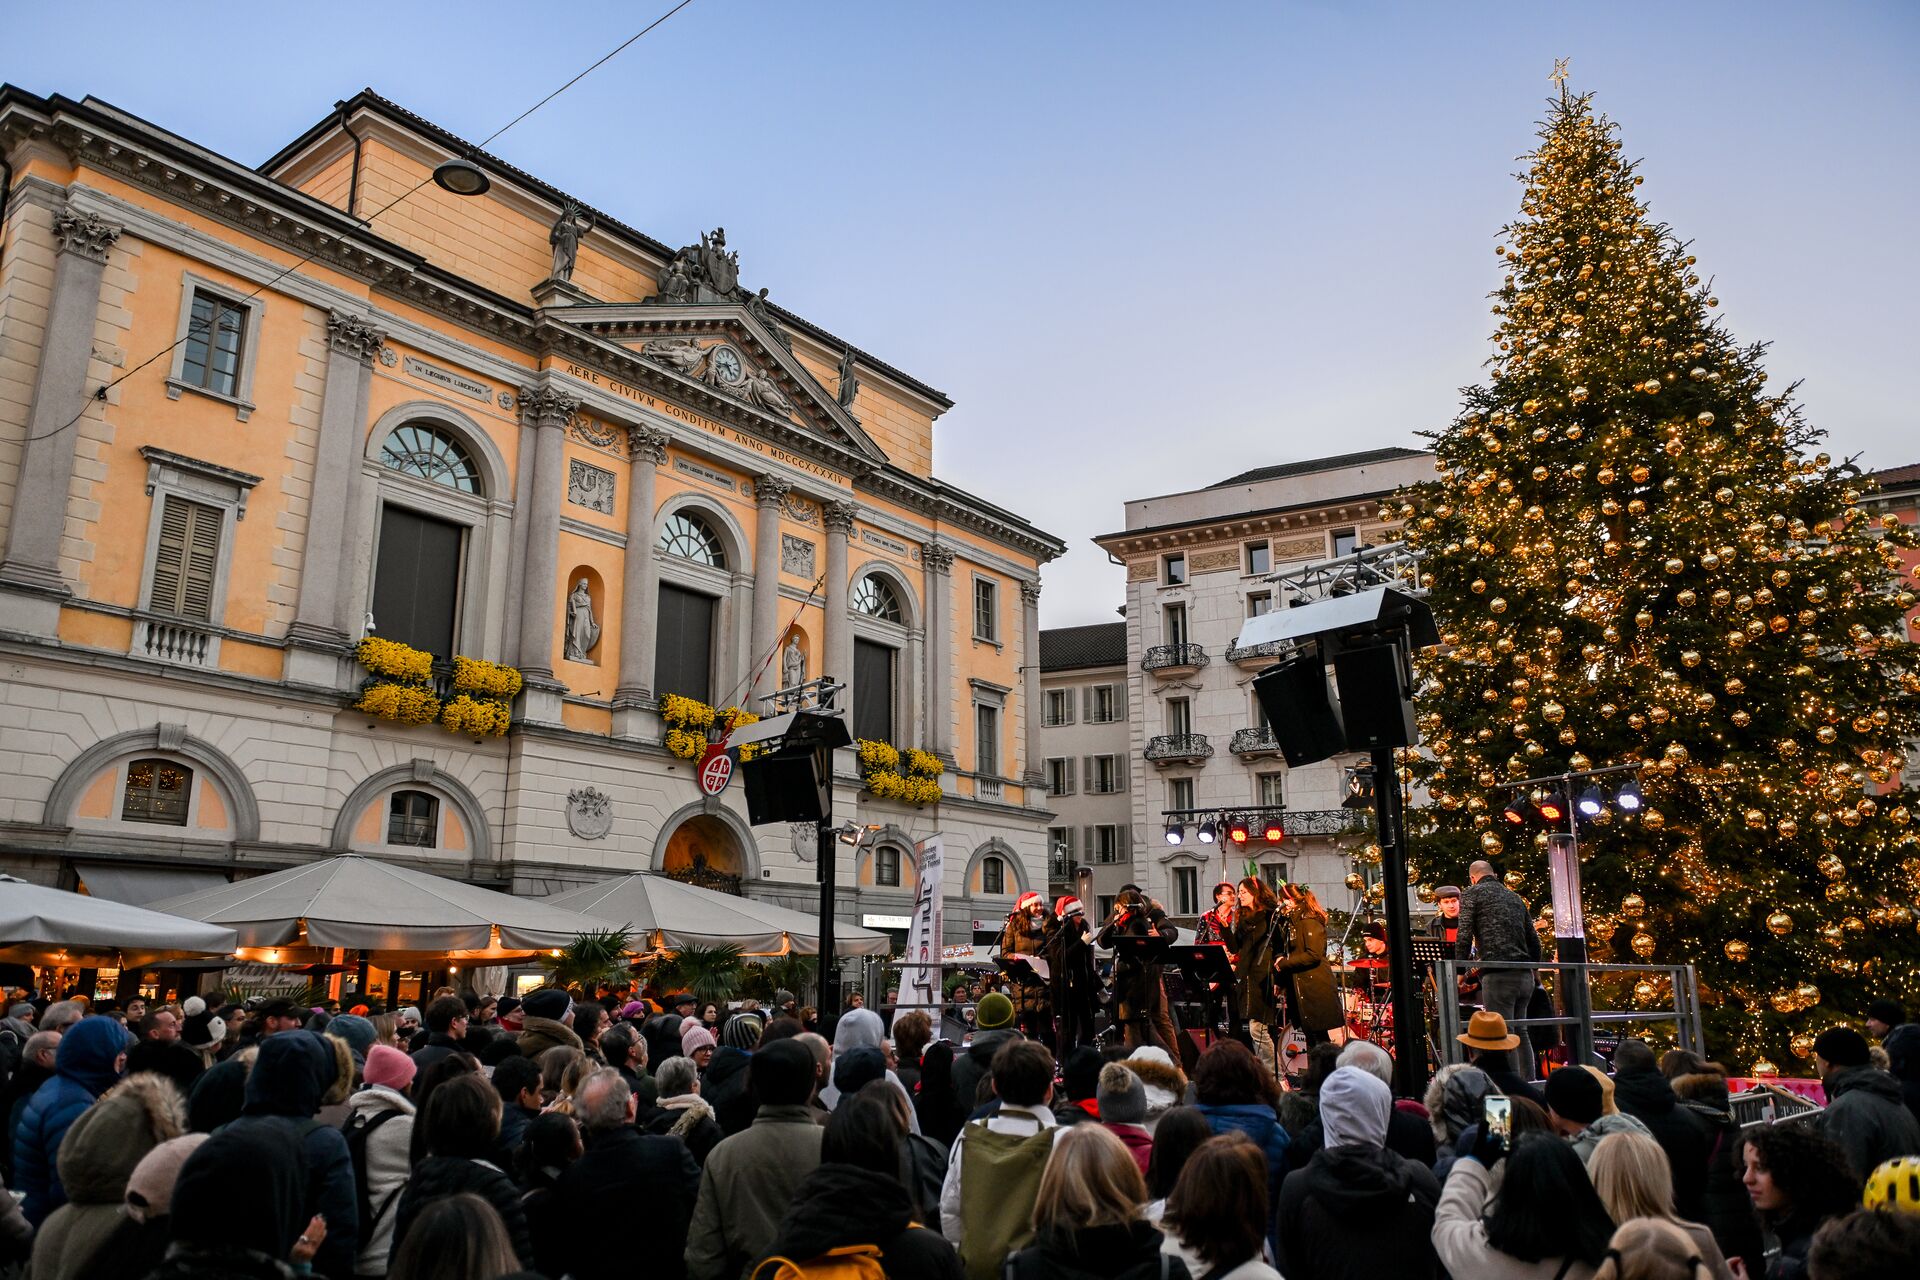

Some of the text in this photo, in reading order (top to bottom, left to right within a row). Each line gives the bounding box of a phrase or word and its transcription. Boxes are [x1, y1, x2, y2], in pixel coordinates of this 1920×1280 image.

[414, 365, 423, 373] IN
[566, 364, 843, 484] AERE CIVIVM CONDITVM ANNO MDCCCXXXXIV
[1291, 1032, 1306, 1042] TAM
